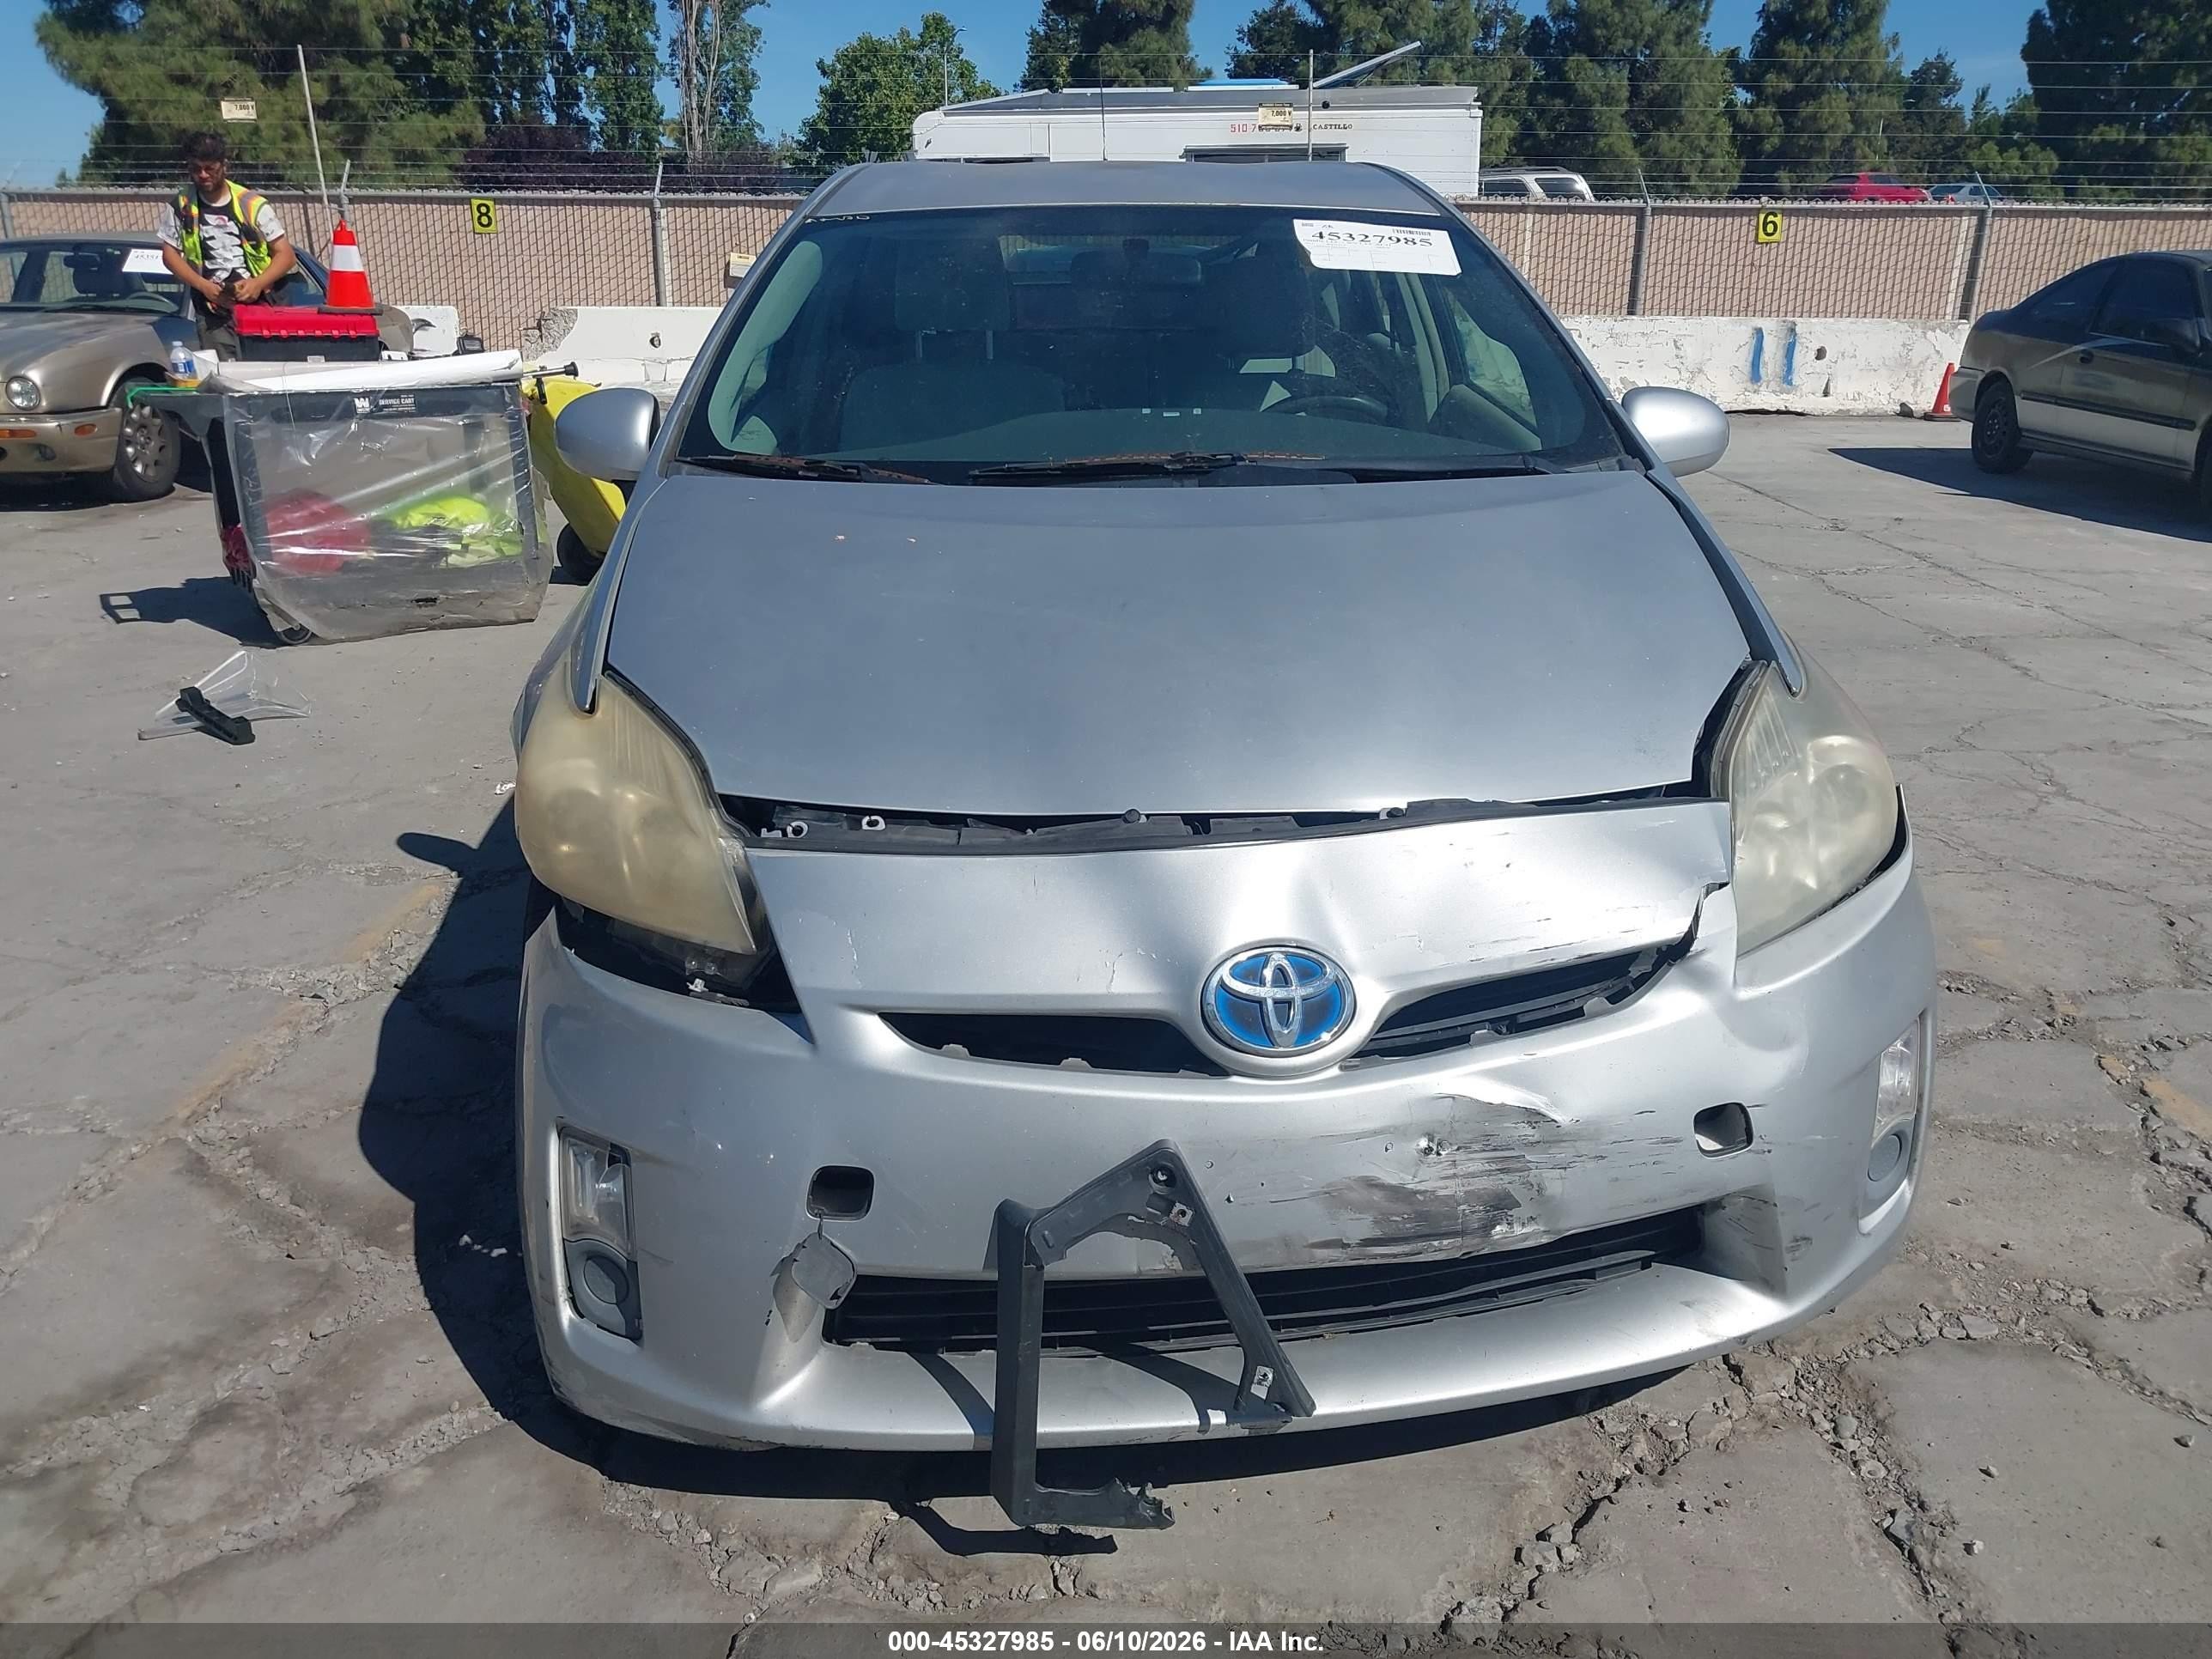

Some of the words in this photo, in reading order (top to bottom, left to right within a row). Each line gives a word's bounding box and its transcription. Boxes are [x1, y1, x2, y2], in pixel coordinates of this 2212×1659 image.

[477, 203, 493, 228] 8
[1762, 211, 1778, 237] 6
[1311, 231, 1433, 247] 45327985
